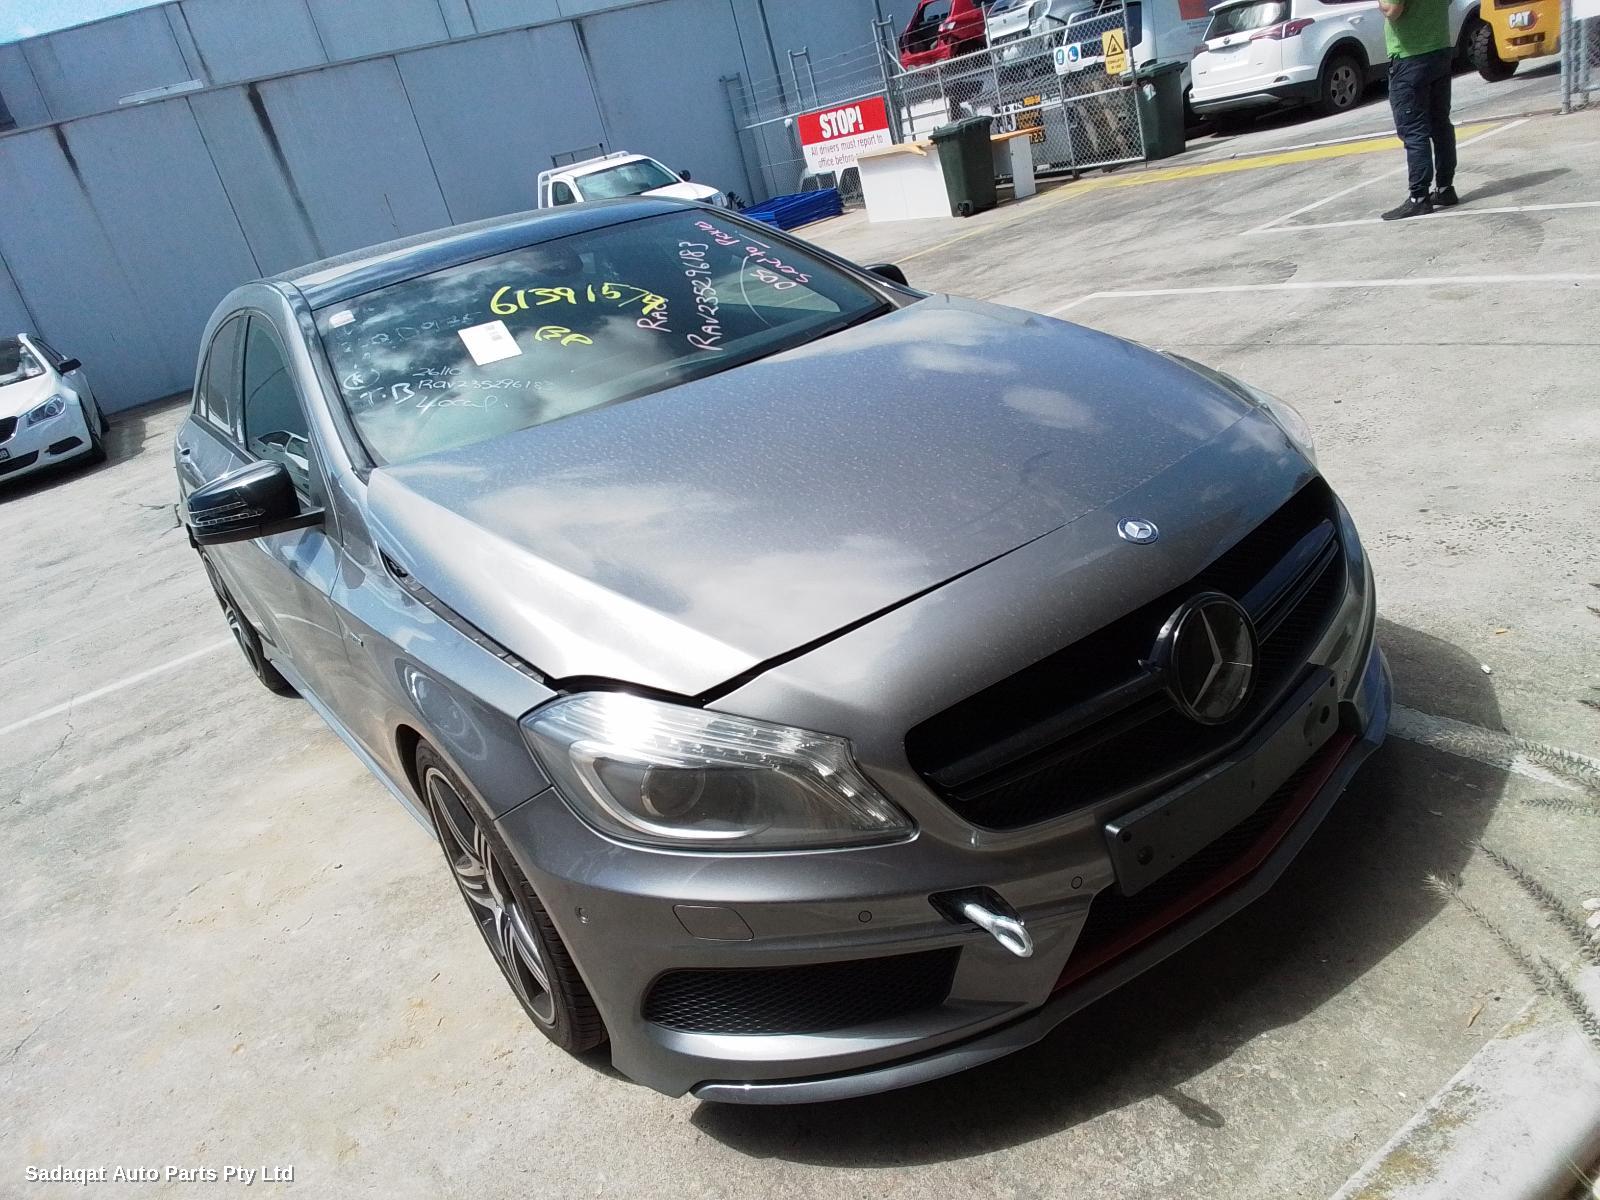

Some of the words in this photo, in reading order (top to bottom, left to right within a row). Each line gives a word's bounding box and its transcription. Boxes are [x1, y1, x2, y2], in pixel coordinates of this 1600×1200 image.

[1508, 11, 1531, 28] CAT
[819, 105, 864, 139] STOP!
[811, 146, 819, 157] All
[820, 144, 840, 155] drivers
[841, 138, 857, 150] must
[857, 135, 876, 148] report
[876, 134, 883, 144] to
[818, 157, 835, 168] office
